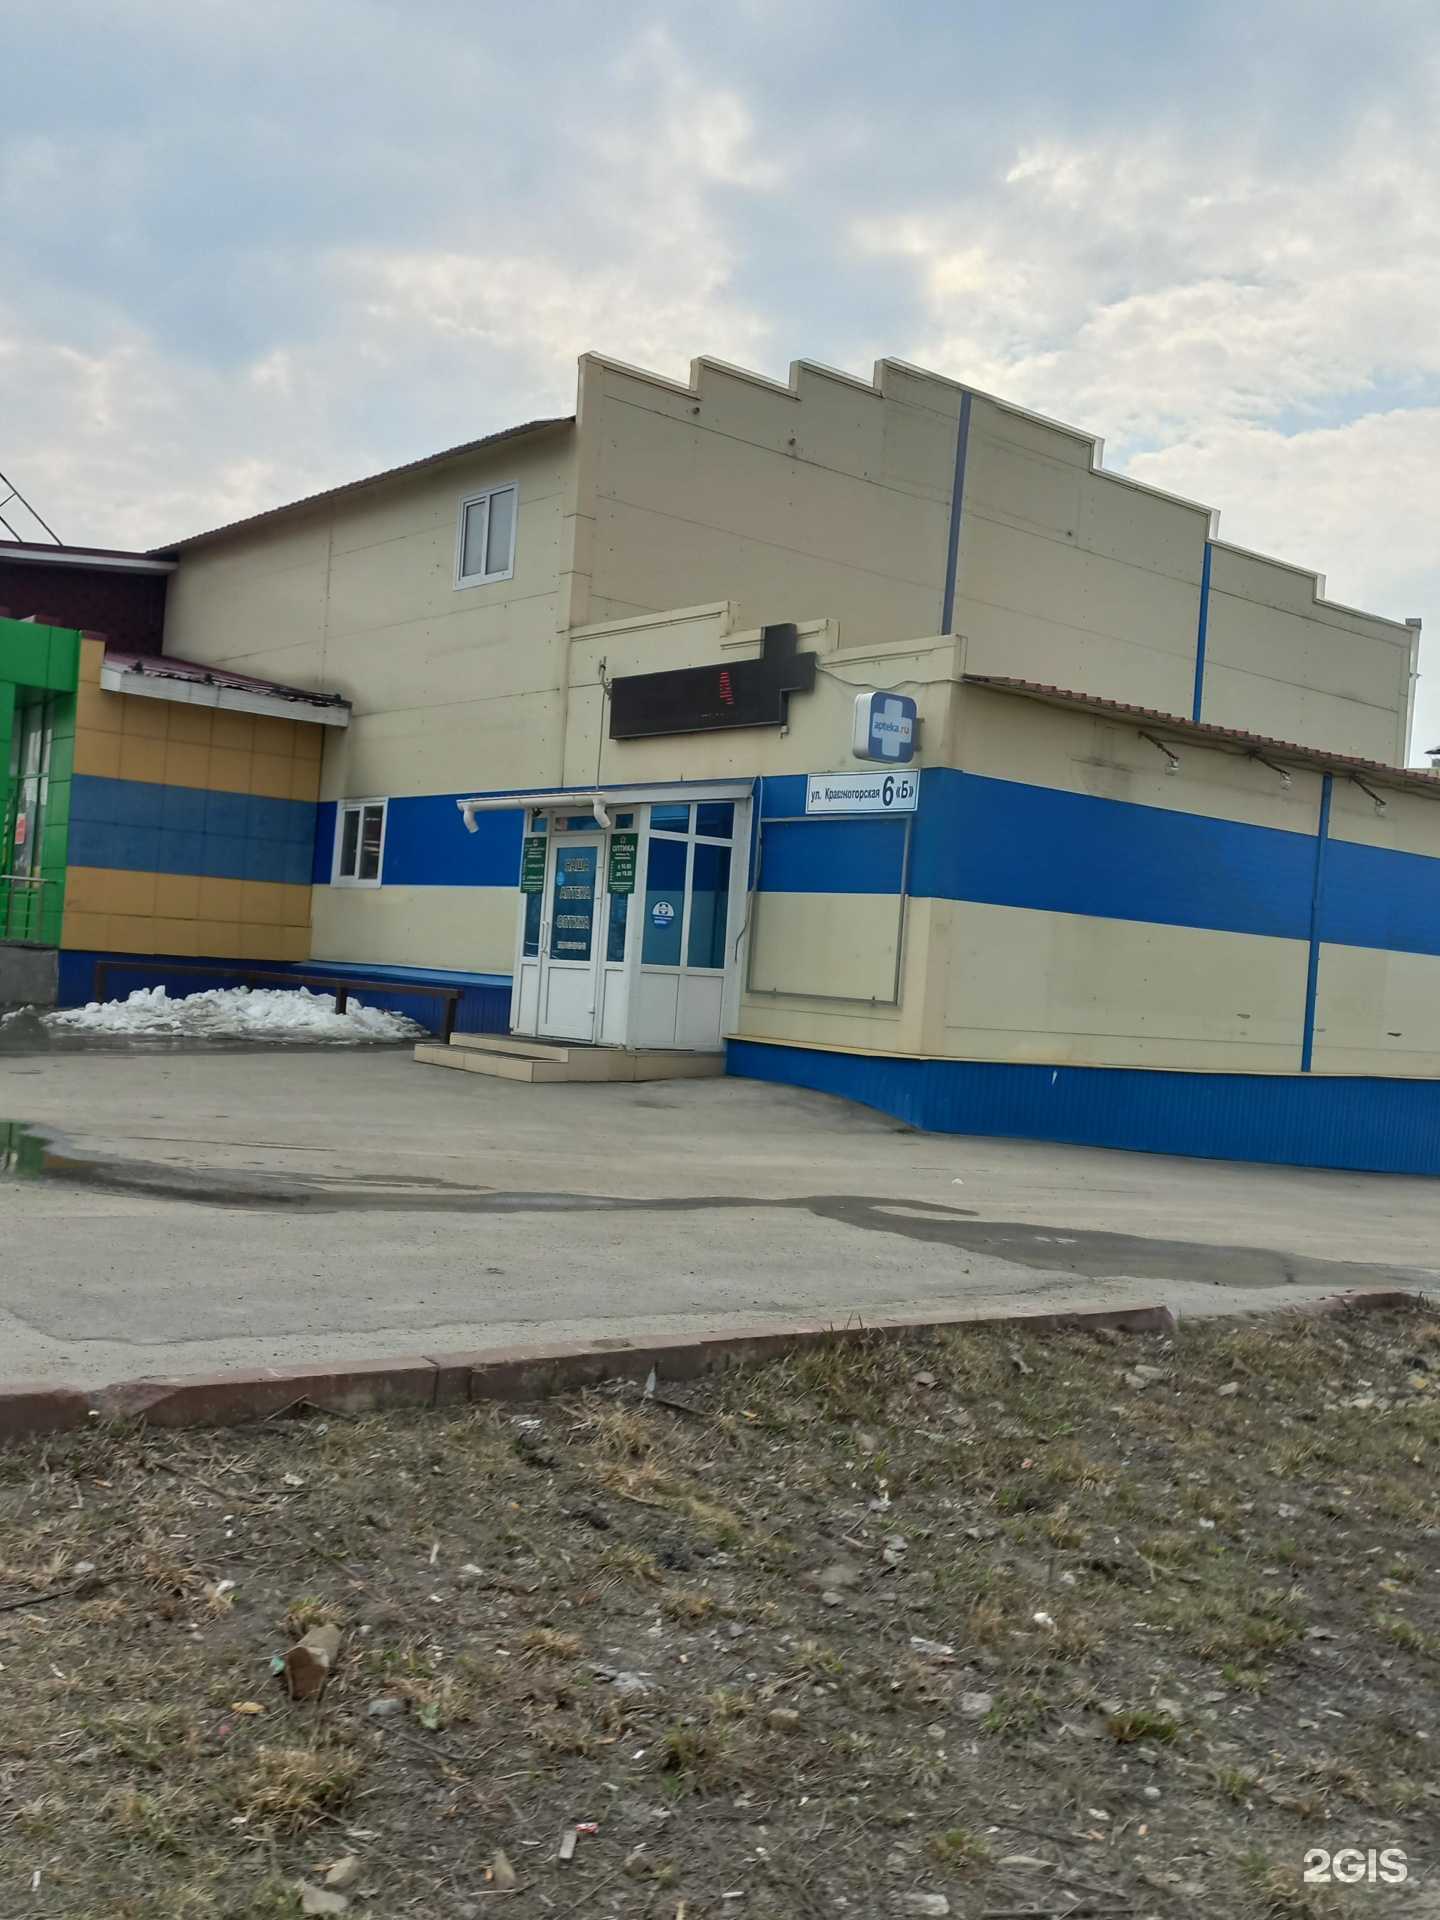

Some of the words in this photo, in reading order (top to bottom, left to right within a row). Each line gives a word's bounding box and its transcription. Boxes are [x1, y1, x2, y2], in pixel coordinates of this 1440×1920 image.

[873, 719, 910, 735] apteka.ru
[811, 790, 821, 803] ул.
[882, 775, 895, 807] 6
